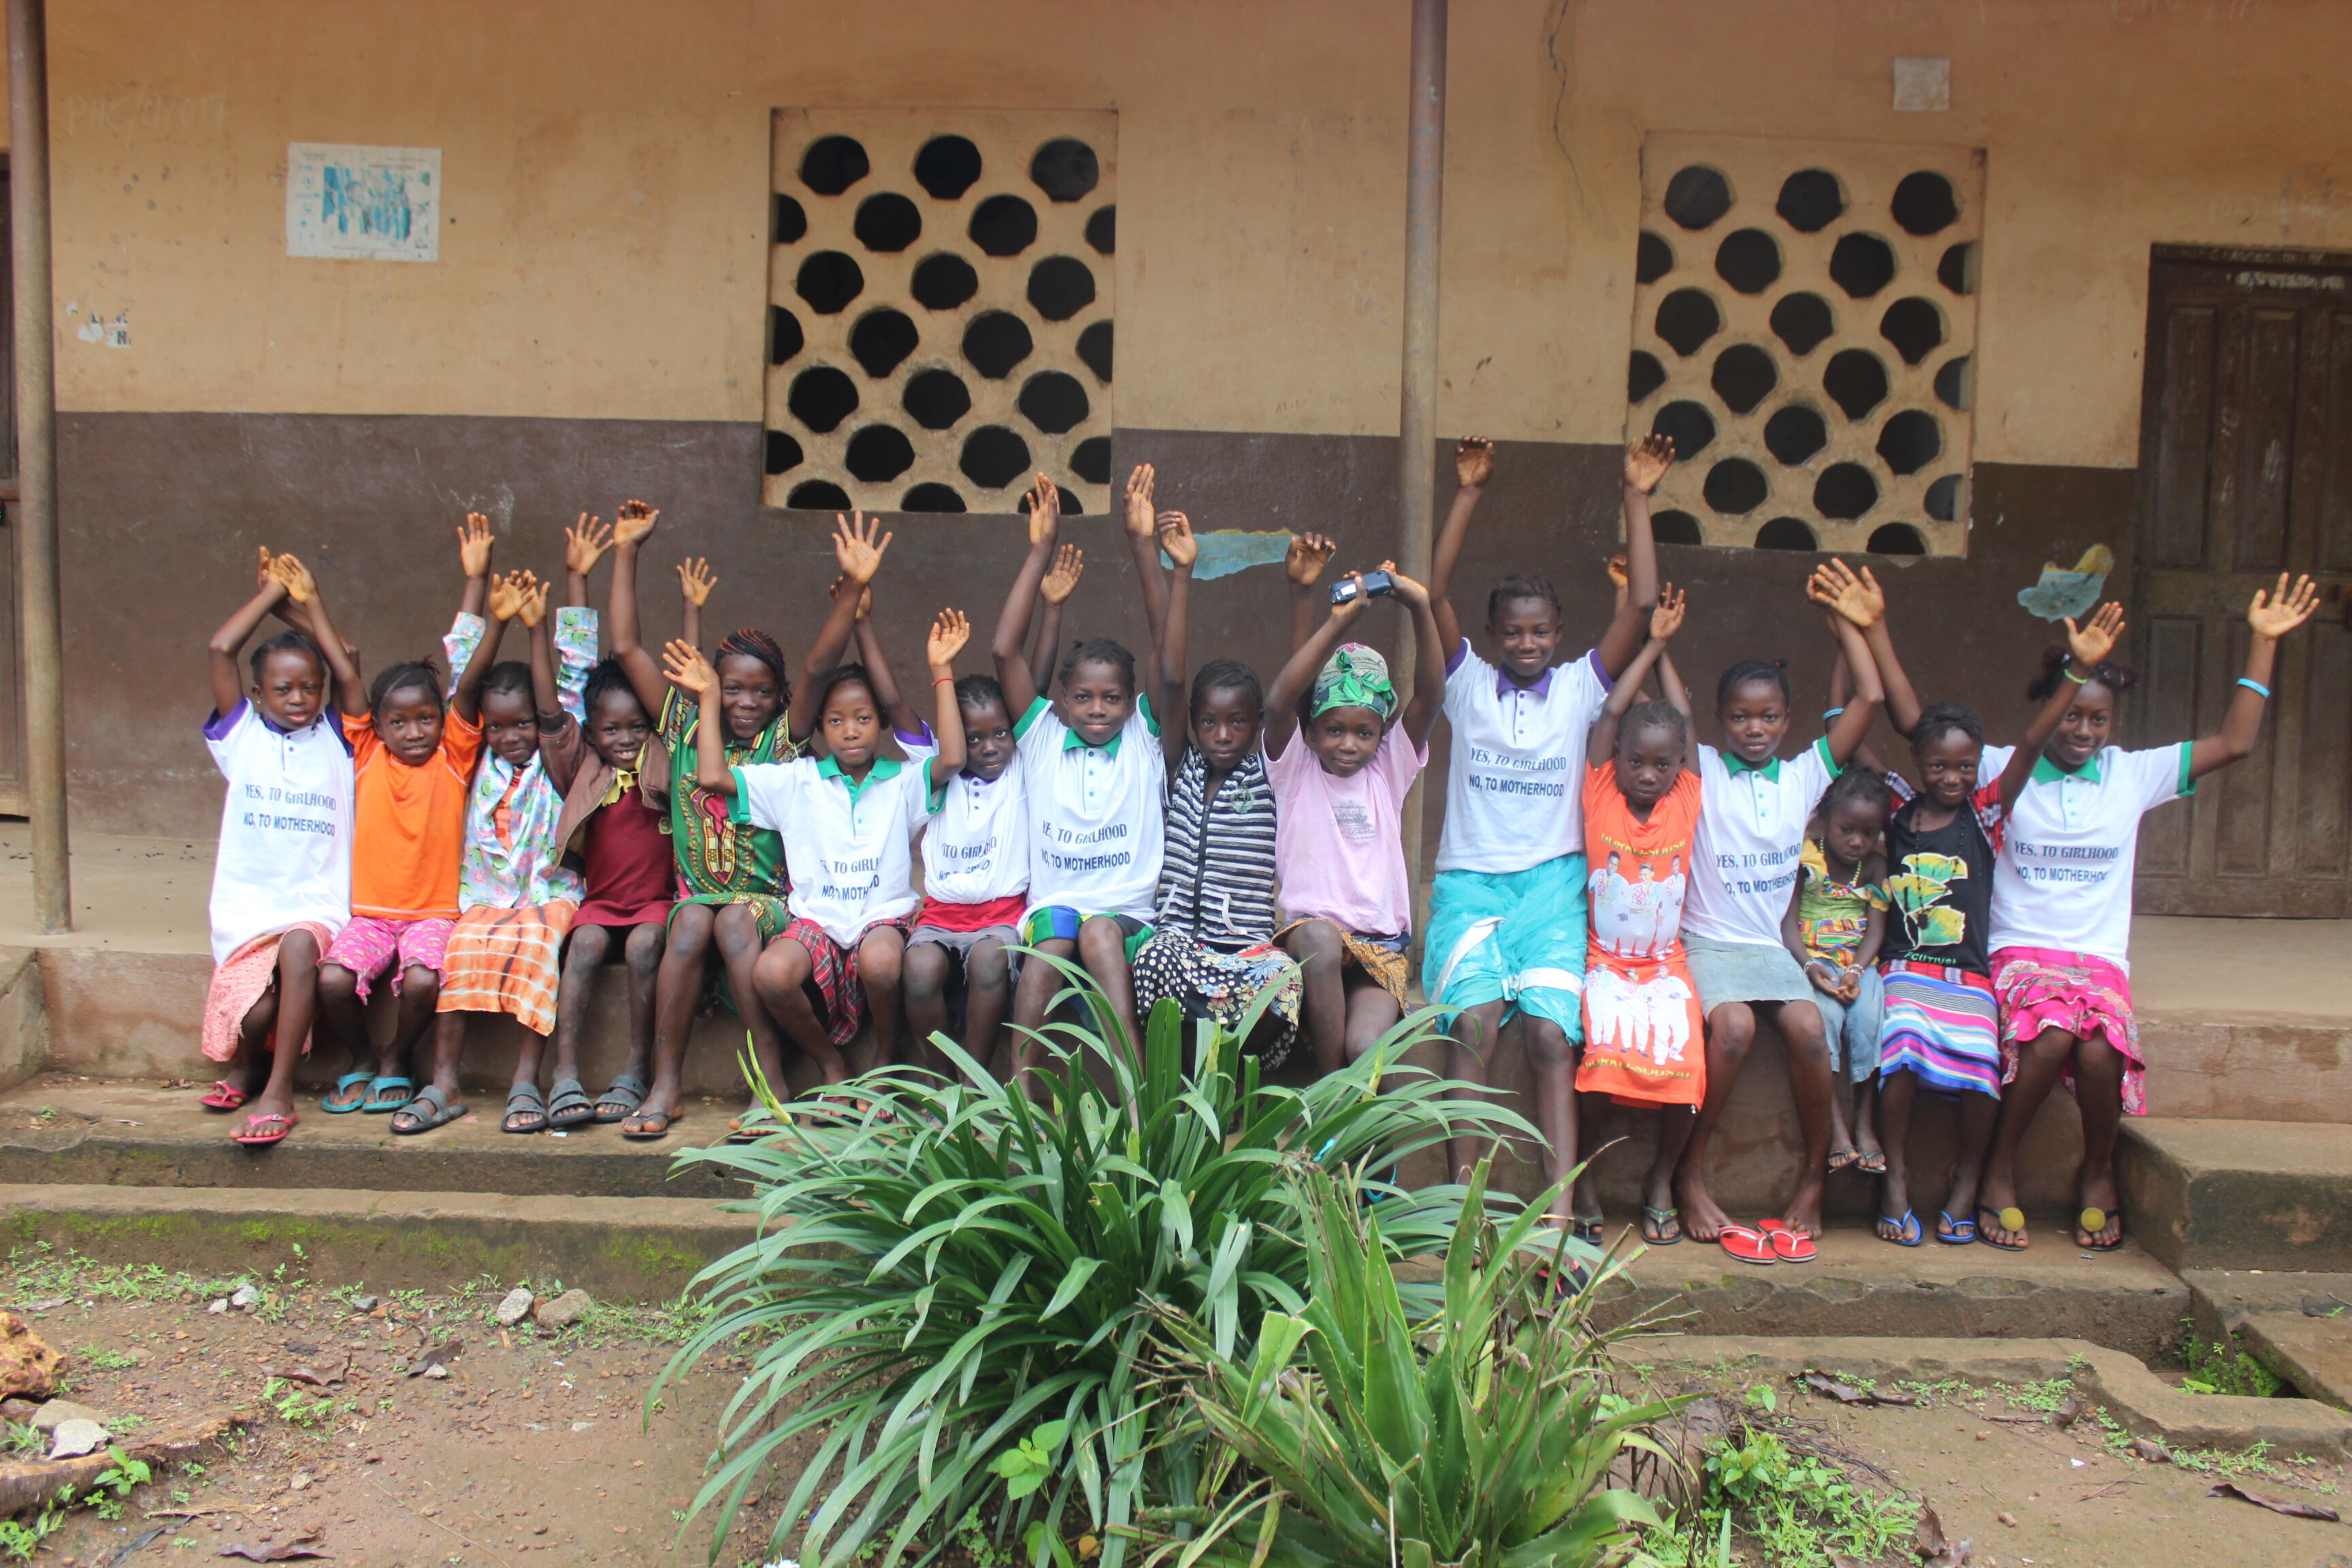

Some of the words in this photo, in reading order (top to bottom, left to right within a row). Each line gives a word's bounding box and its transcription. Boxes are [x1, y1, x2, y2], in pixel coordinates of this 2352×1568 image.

[1471, 747, 1490, 765] YES,
[1495, 754, 1509, 766] TO
[1512, 757, 1566, 770] GIRLHOOD
[1469, 774, 1482, 791] NO,
[1486, 777, 1497, 790] TO
[1499, 779, 1564, 797] MOTHERHOOD
[245, 783, 264, 801] YES,
[270, 787, 282, 801] TO
[285, 791, 337, 811] GIRLHOOD
[244, 811, 256, 829] NO,
[259, 813, 271, 828] TO
[274, 815, 336, 836] MOTHERHOOD
[1058, 828, 1072, 843] TO
[2015, 841, 2037, 858] YES,
[2042, 845, 2057, 858] TO
[2061, 847, 2119, 860] GIRLHOOD
[833, 861, 848, 875] TO
[1051, 853, 1062, 868] TO
[1064, 851, 1130, 871] MOTHERHOOD
[1716, 854, 1738, 870] YES,
[1742, 854, 1757, 868] TO
[2034, 867, 2046, 880] TO
[1722, 882, 1735, 897] O,
[1737, 881, 1750, 894] TO
